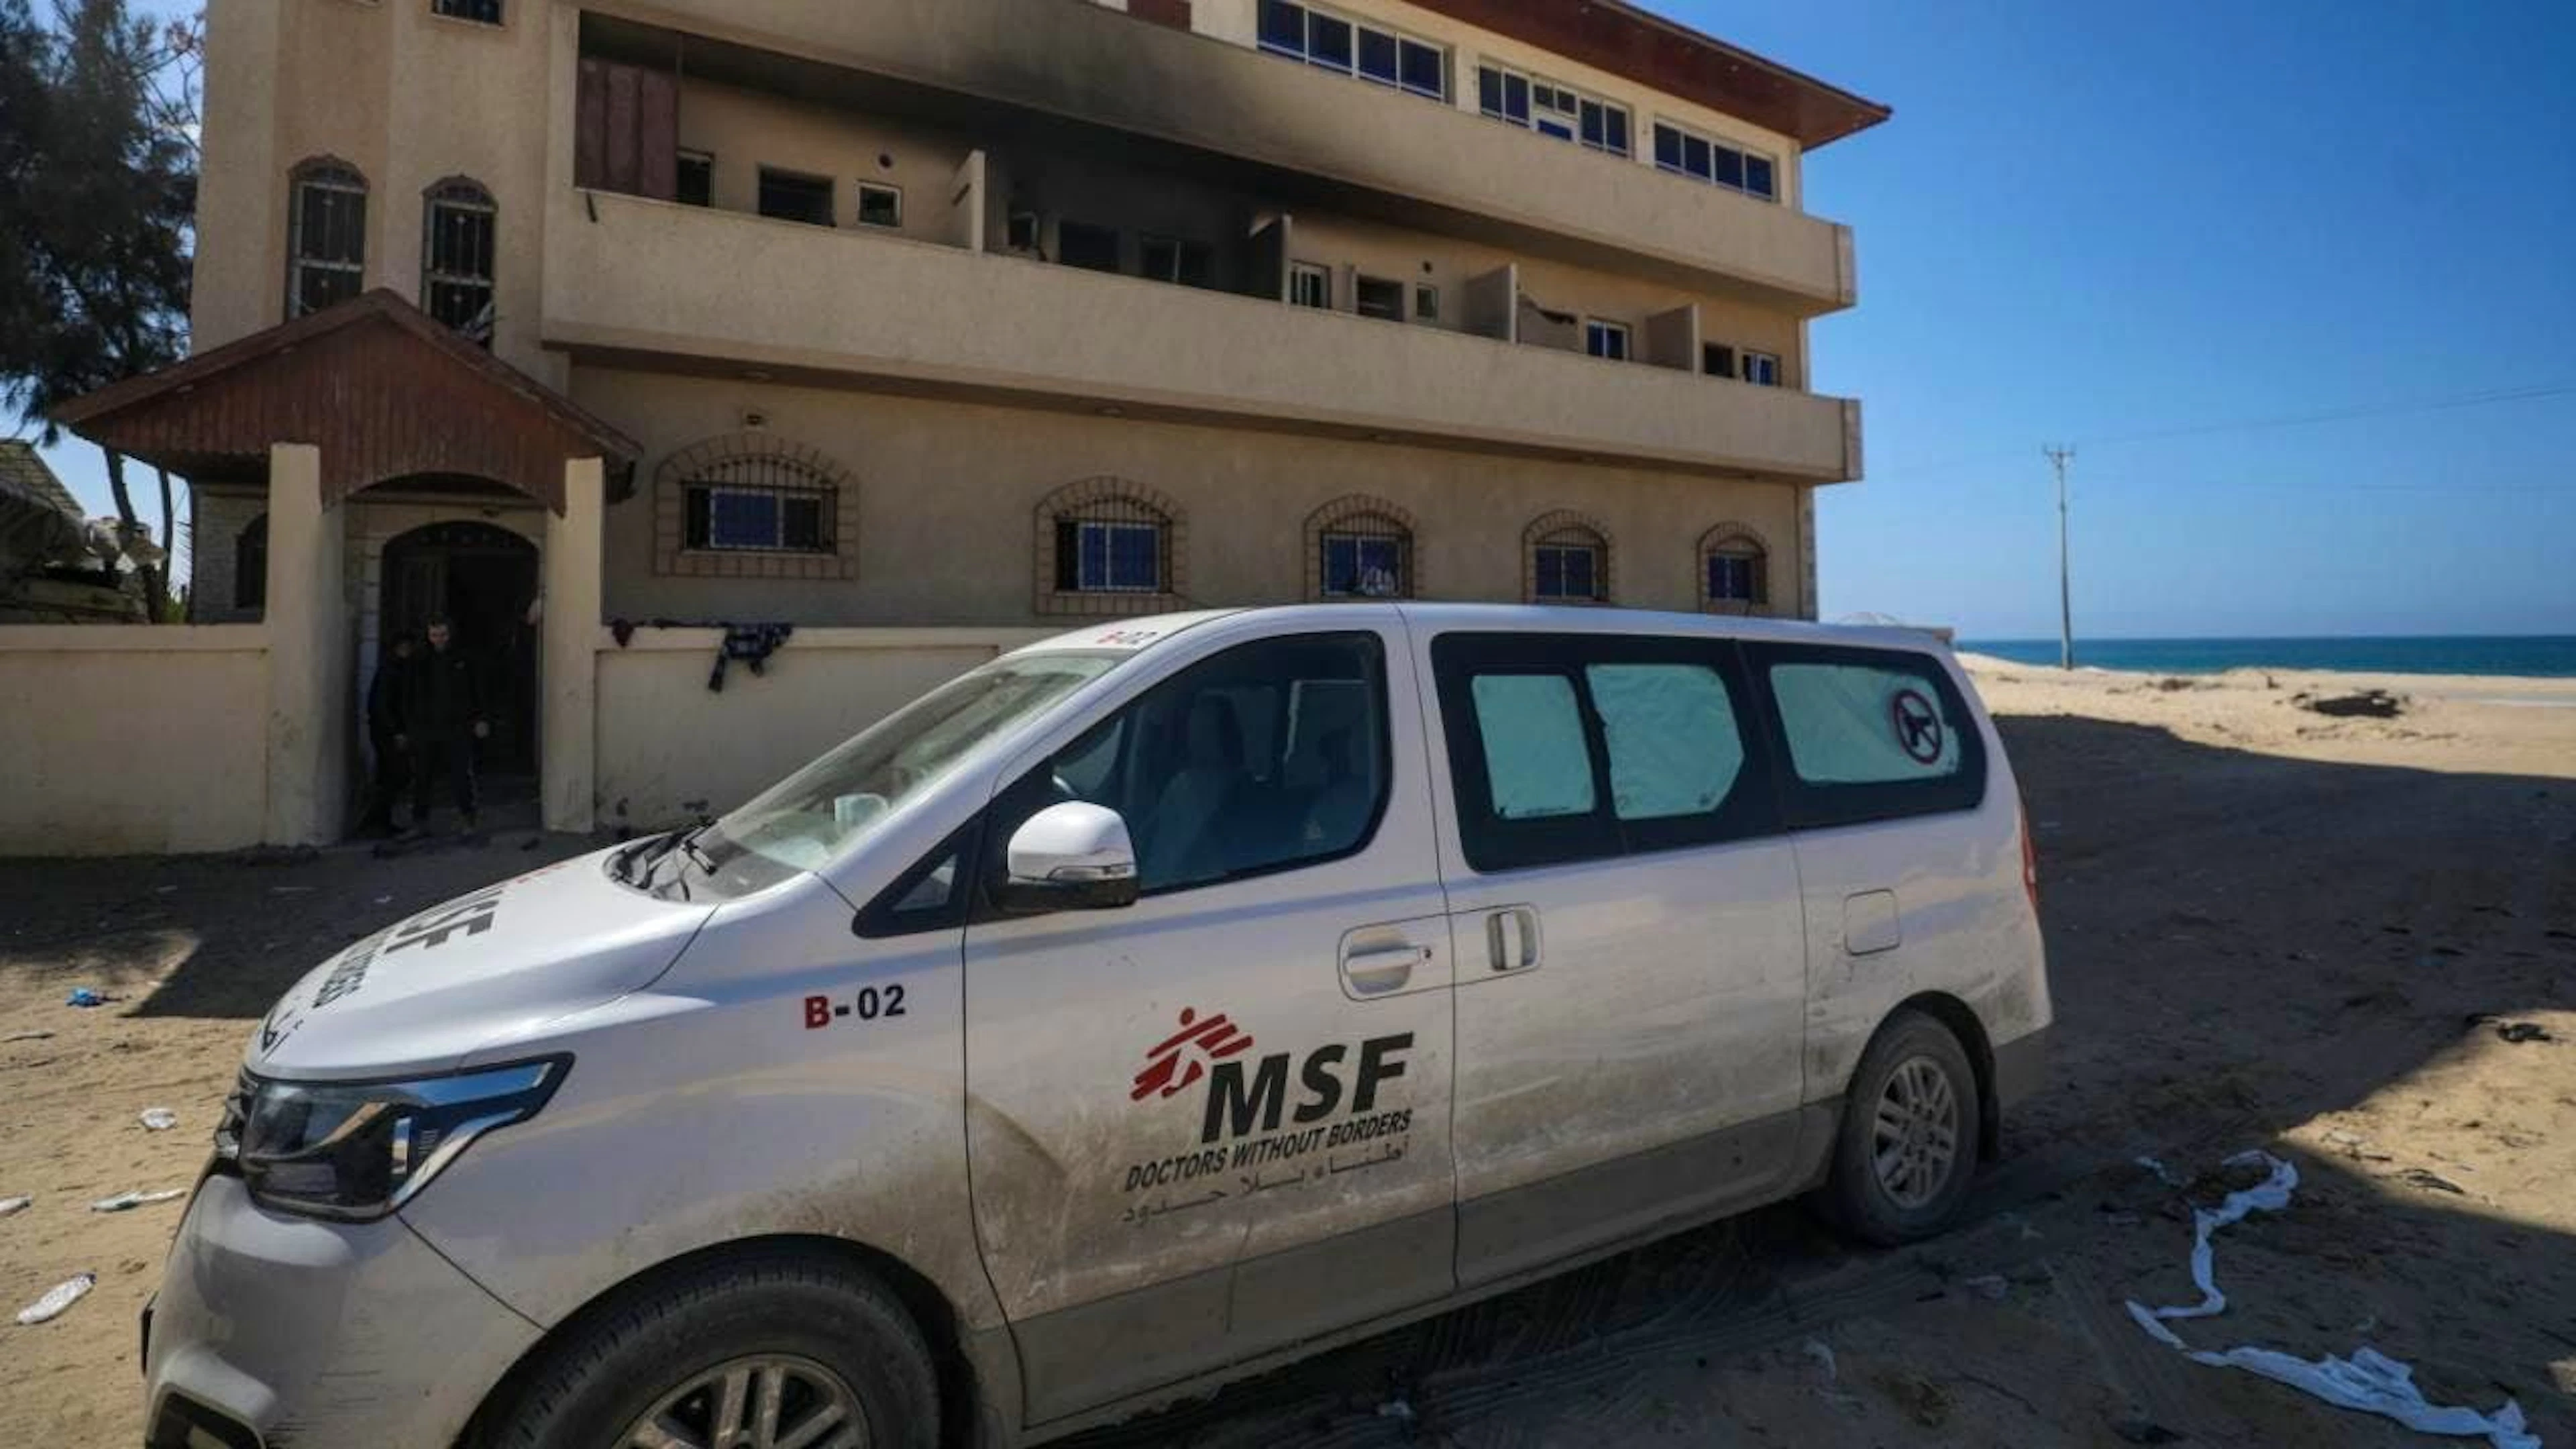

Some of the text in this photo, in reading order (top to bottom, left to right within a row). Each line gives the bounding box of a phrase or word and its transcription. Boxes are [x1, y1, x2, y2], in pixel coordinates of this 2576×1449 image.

[804, 983, 906, 1030] B-02
[1201, 1032, 1413, 1143] MSF
[1125, 1108, 1413, 1191] DOCTORS WITHOUT BORDERS
